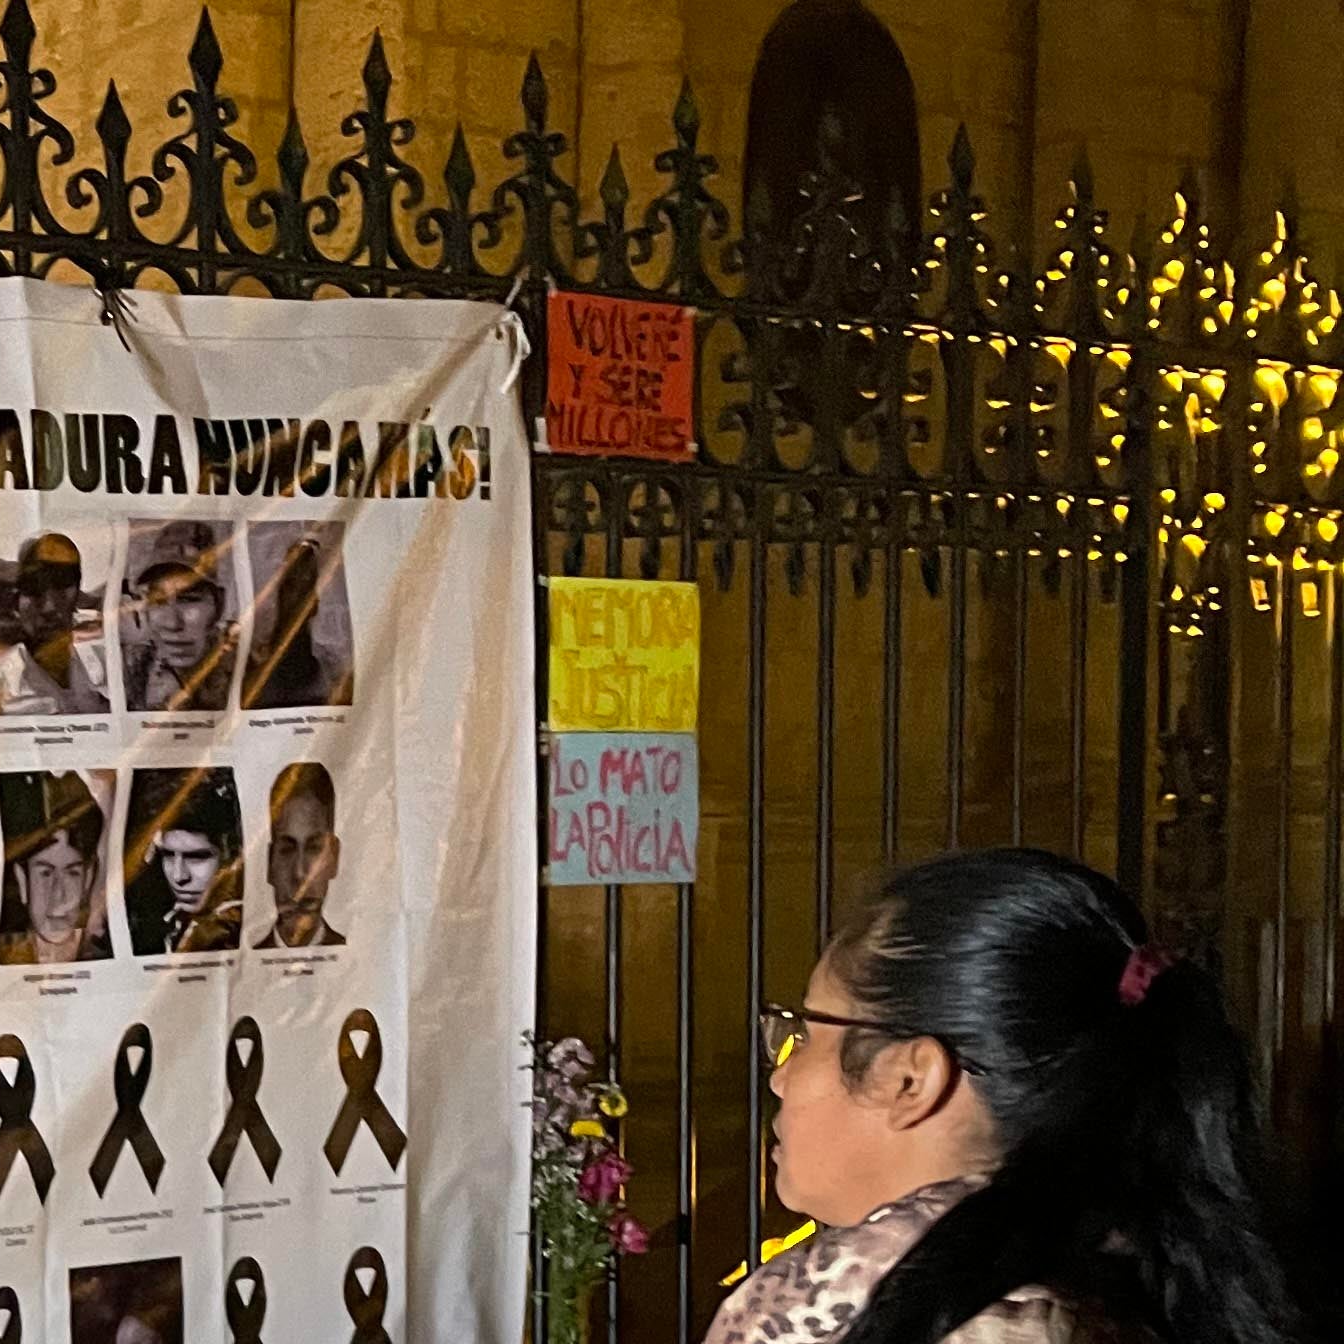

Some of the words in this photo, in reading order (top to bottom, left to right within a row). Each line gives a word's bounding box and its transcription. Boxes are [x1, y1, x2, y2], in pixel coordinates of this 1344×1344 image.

[194, 417, 365, 500] NUNCA
[599, 744, 682, 797] MATO
[550, 808, 589, 862] LA
